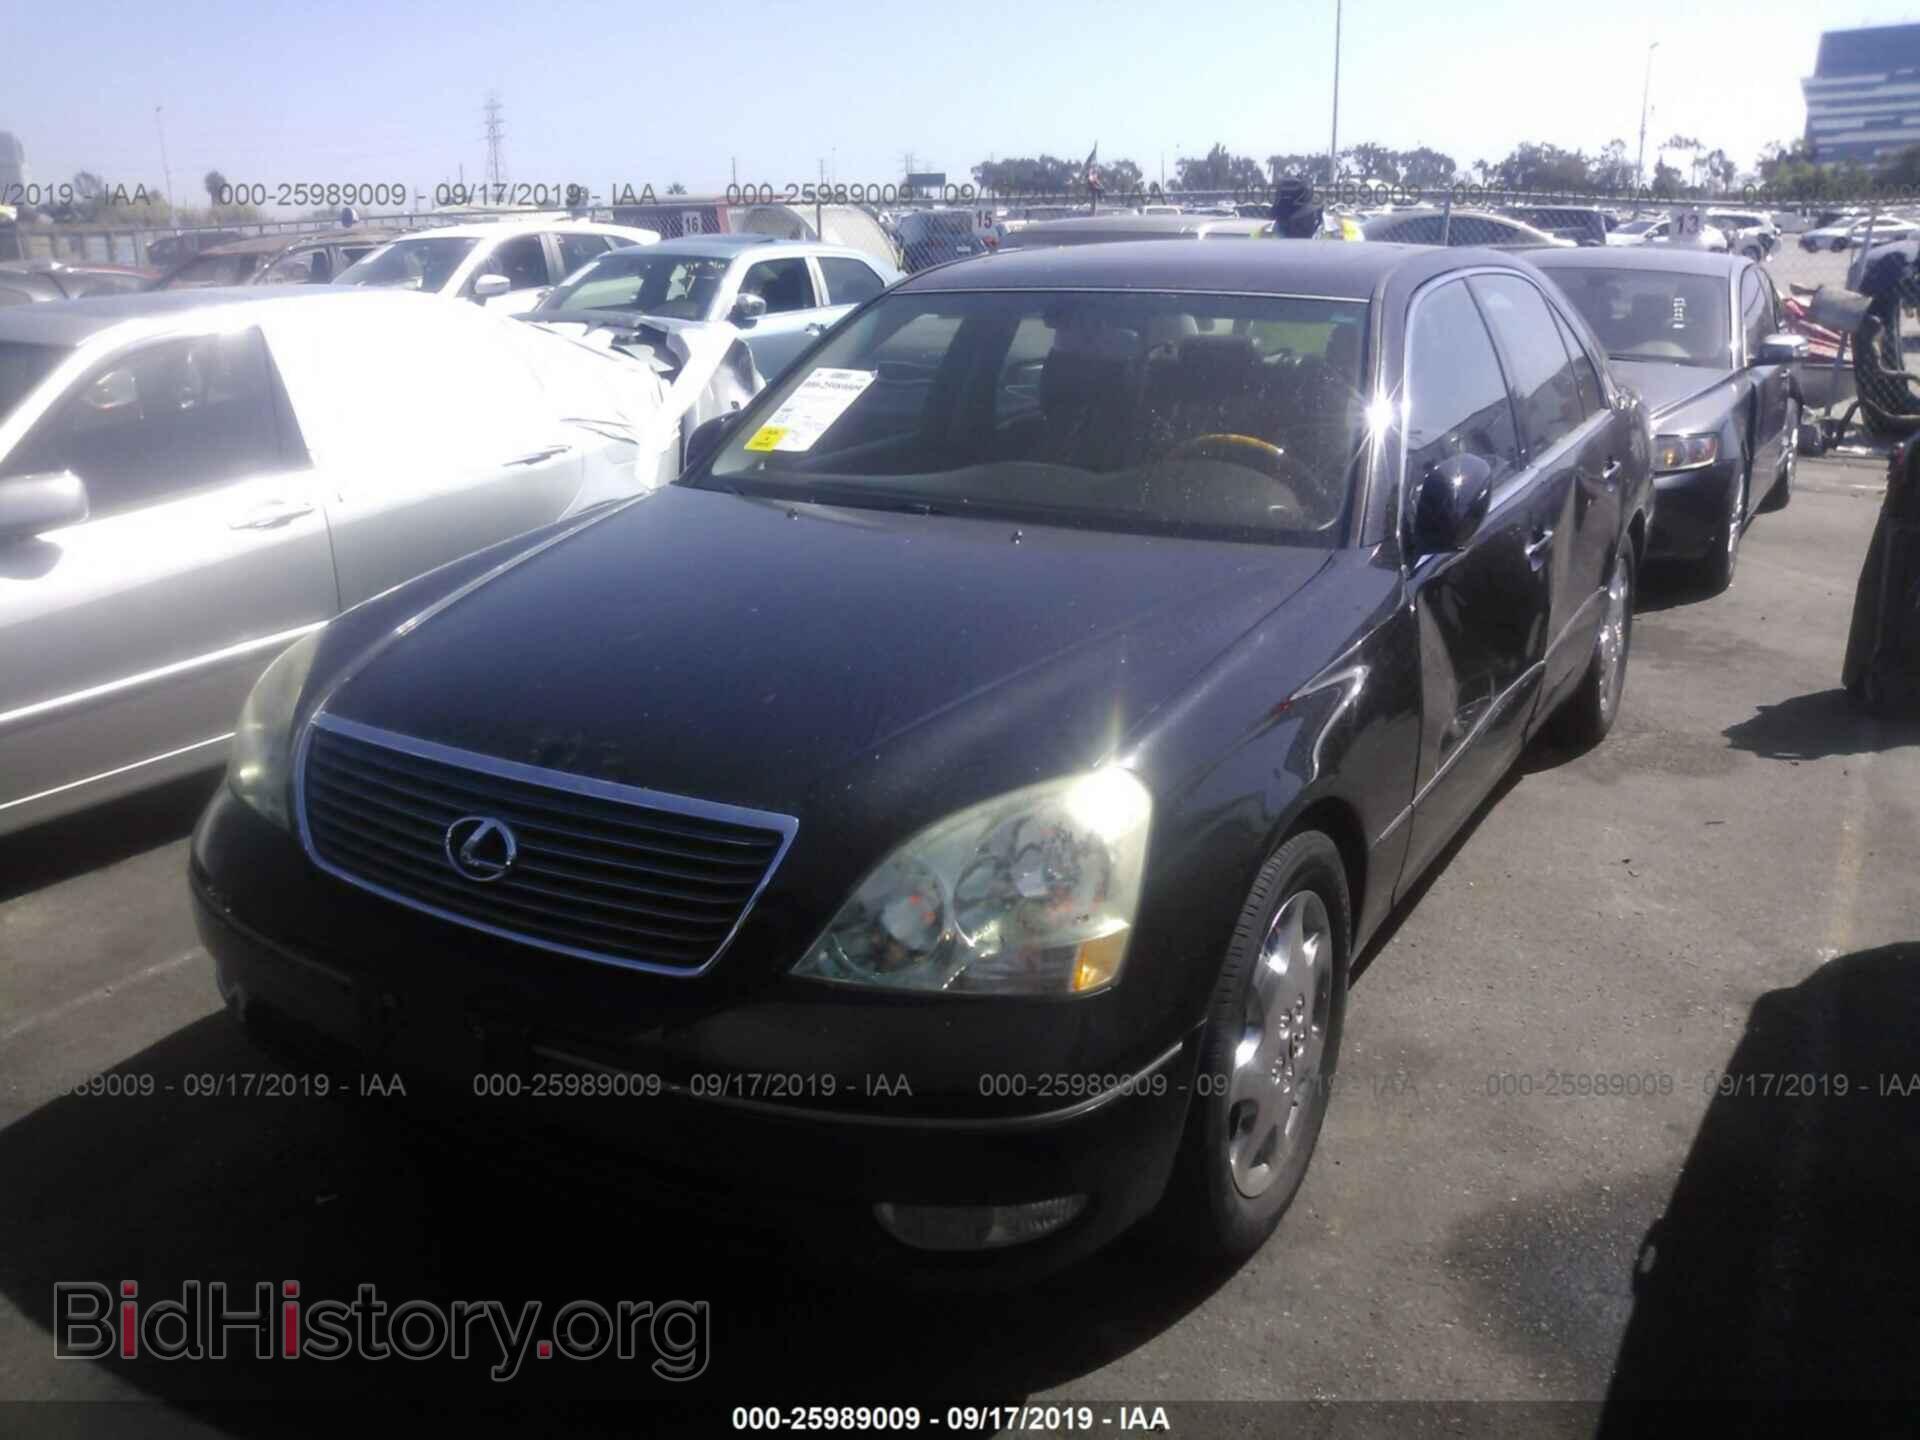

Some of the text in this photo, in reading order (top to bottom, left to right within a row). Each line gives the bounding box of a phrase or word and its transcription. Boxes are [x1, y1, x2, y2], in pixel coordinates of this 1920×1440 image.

[685, 216, 699, 232] 16
[976, 209, 992, 229] 15
[1676, 214, 1699, 234] 13
